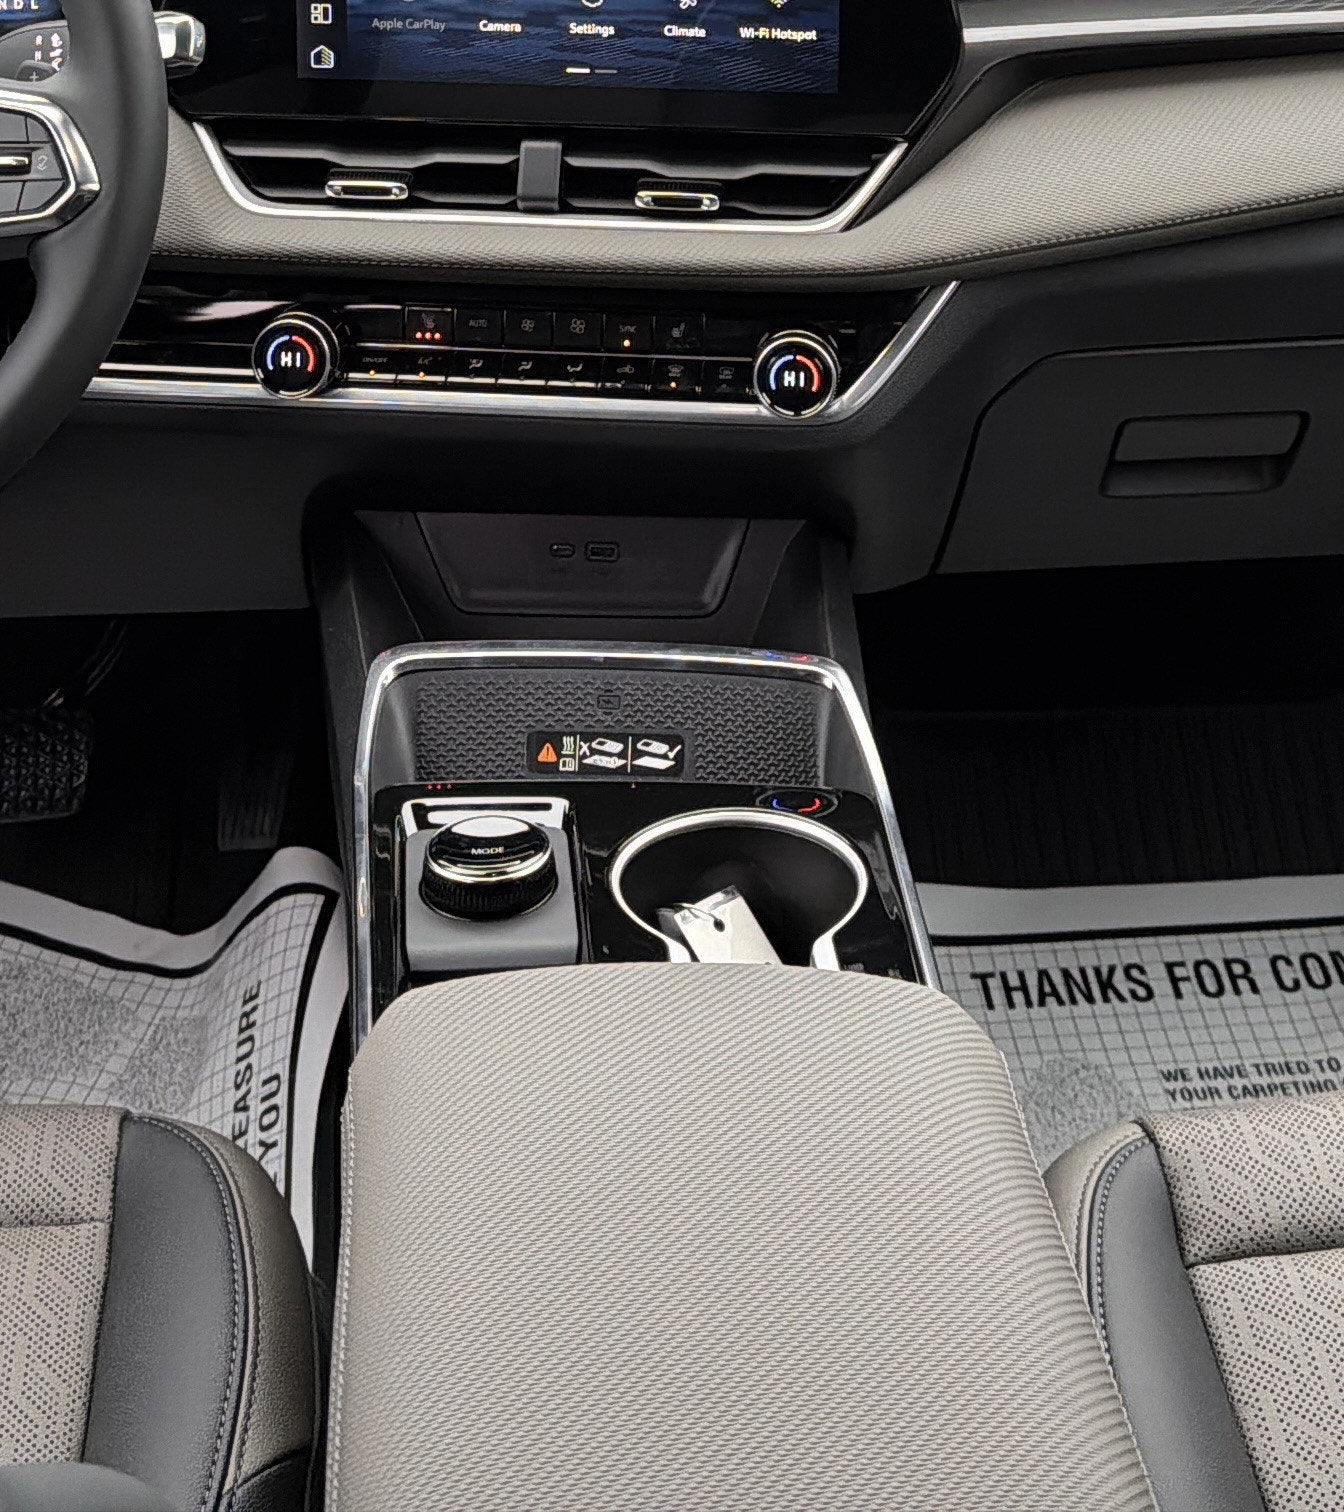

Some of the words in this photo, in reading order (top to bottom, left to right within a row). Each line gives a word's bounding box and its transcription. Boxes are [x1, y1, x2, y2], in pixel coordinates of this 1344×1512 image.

[371, 18, 404, 30] Apple
[405, 18, 447, 32] CarPlay
[478, 20, 522, 33] Camera
[569, 22, 615, 38] Settings
[663, 24, 706, 38] Climate
[739, 26, 770, 39] Wi-Fi
[771, 27, 818, 41] Hotspot
[468, 318, 488, 328] AUTO
[280, 351, 301, 367] HI
[783, 370, 806, 388] HI
[470, 846, 505, 856] MODE
[969, 962, 1155, 1011] THANKS
[1164, 957, 1261, 1000] FOR
[231, 979, 263, 1152] EASURE
[1159, 1067, 1193, 1083] WE
[1196, 1063, 1248, 1082] HAVE
[1250, 1059, 1311, 1079] TRIED
[1313, 1055, 1342, 1074] TO
[1163, 1085, 1223, 1104] YOUR
[1227, 1078, 1337, 1101] CARPETING
[258, 1072, 283, 1164] YOU
